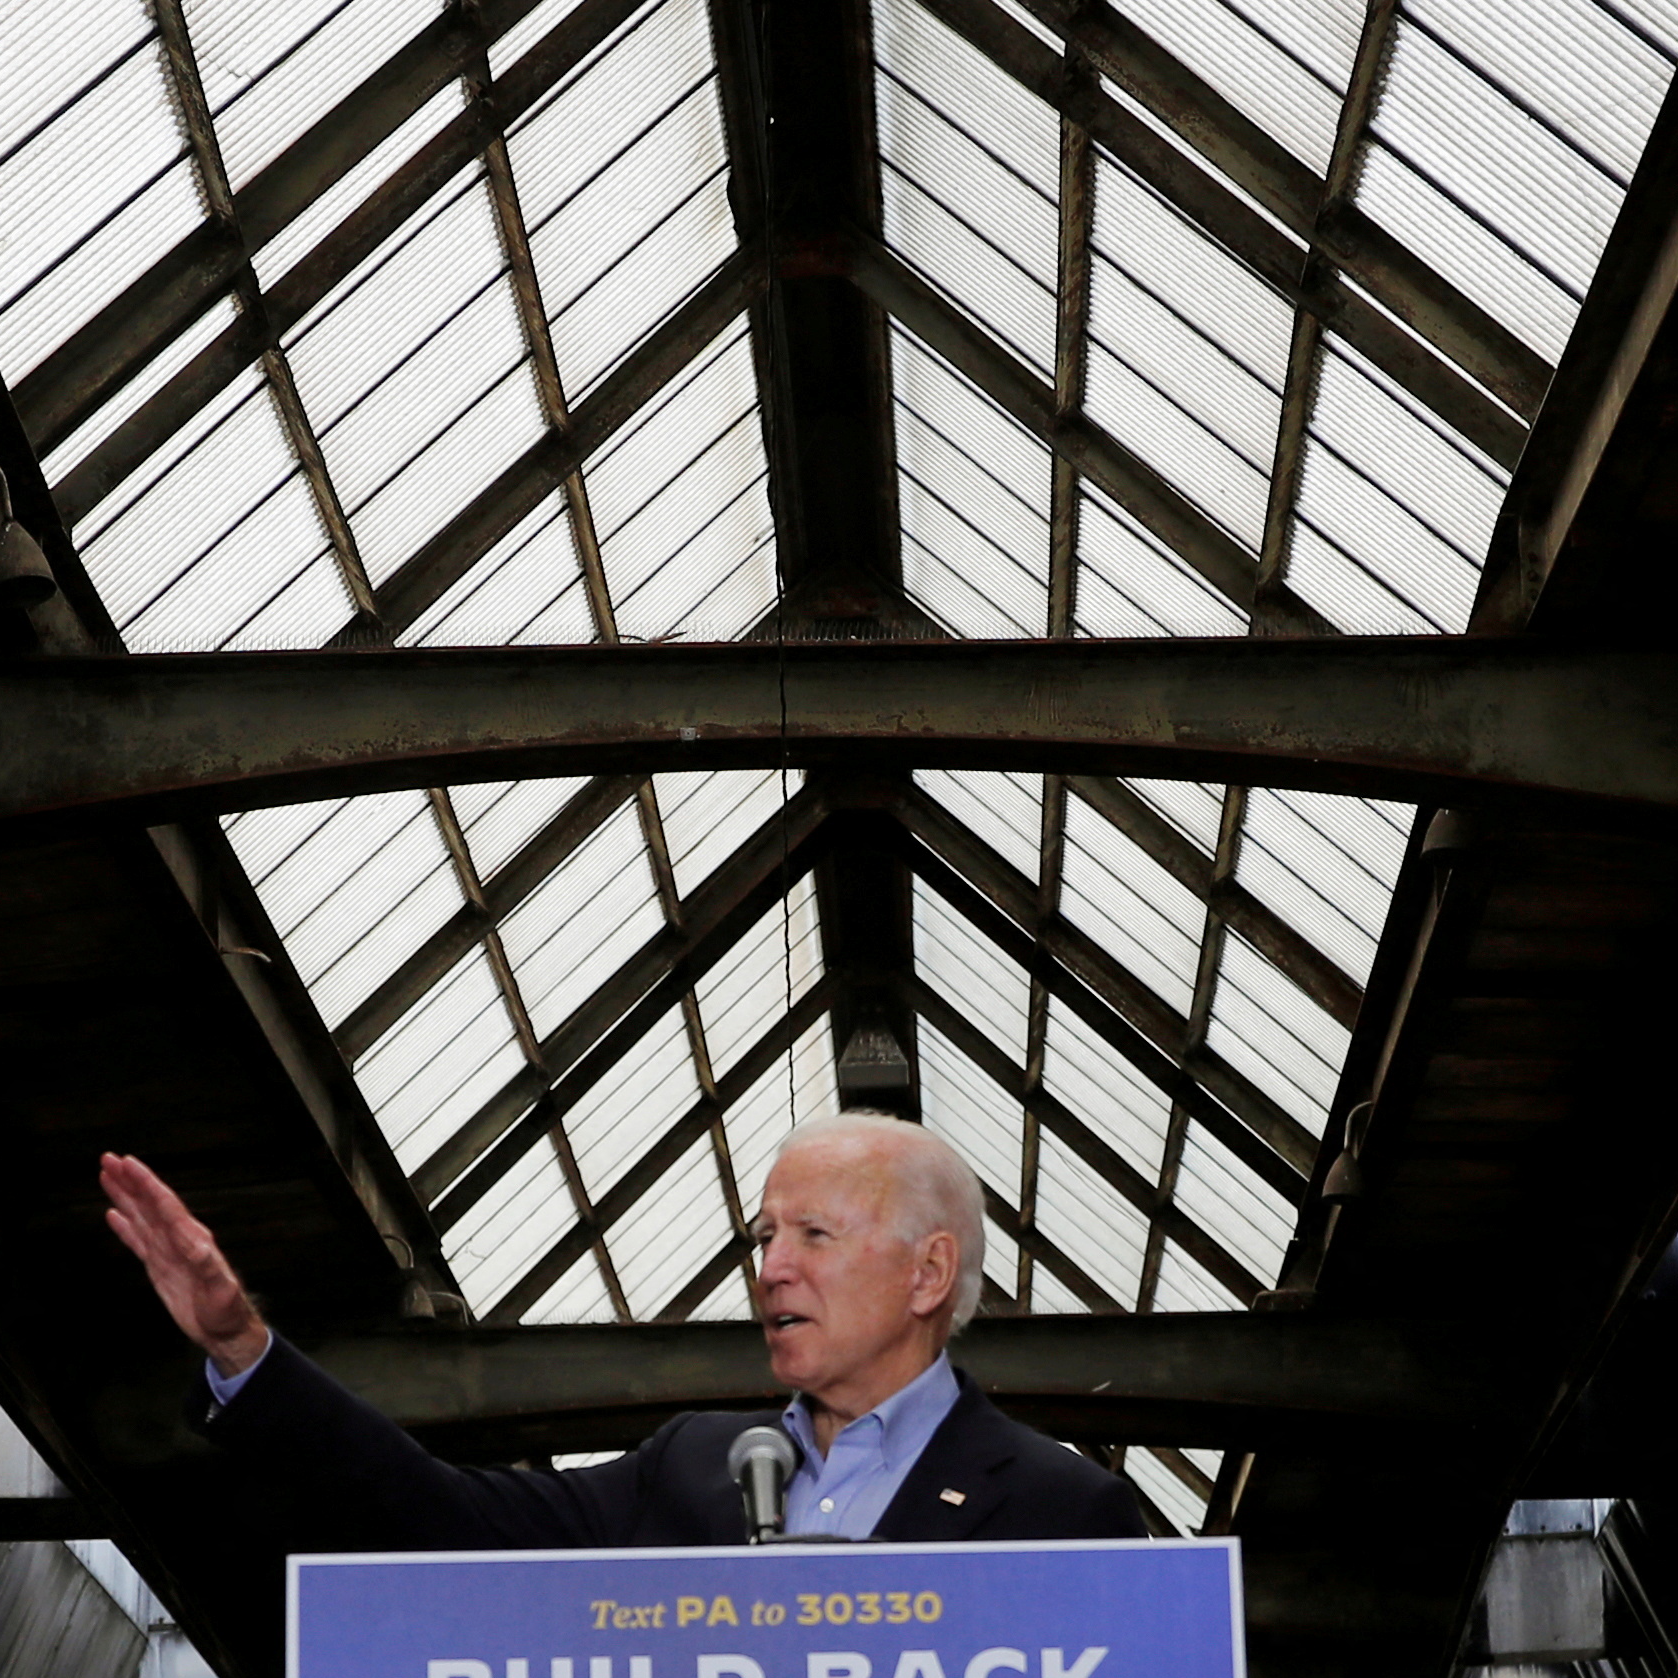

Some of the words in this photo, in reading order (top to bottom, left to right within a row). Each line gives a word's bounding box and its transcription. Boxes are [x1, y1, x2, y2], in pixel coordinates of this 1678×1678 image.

[589, 1599, 665, 1631] Text
[675, 1593, 741, 1629] PA
[750, 1599, 787, 1628] to
[795, 1590, 944, 1627] 30330
